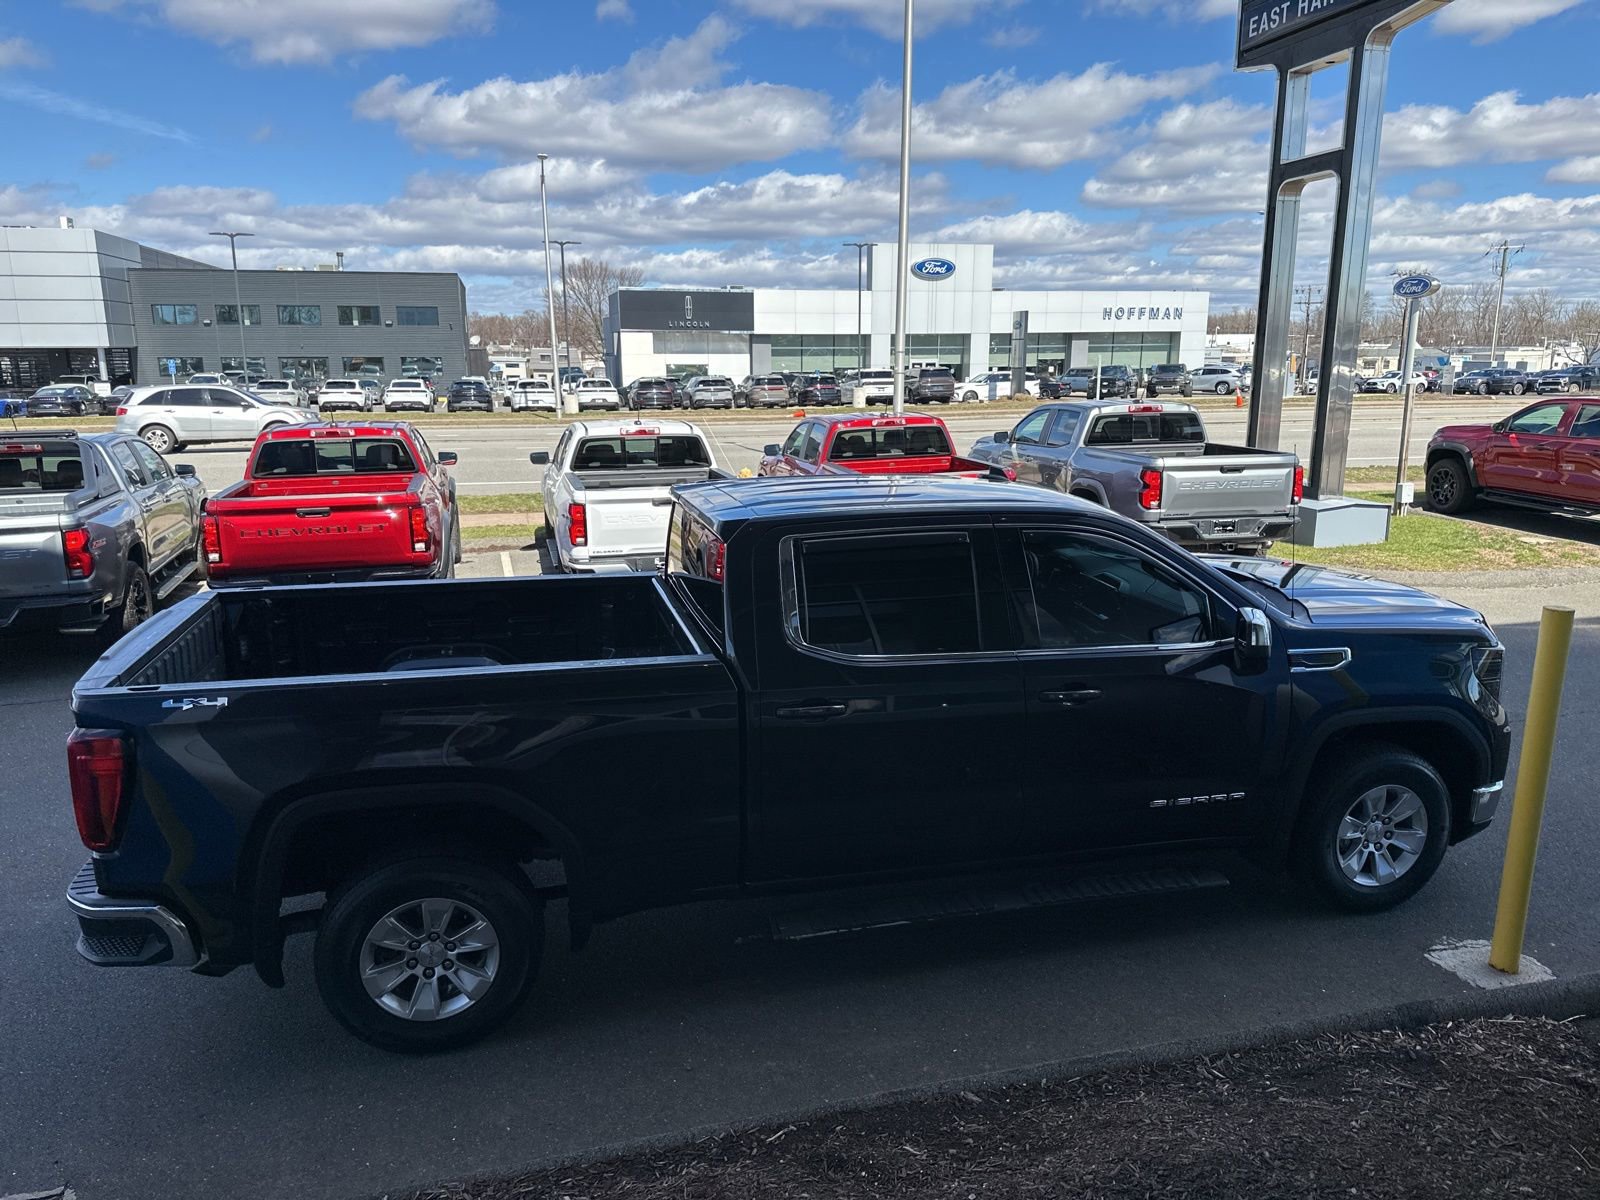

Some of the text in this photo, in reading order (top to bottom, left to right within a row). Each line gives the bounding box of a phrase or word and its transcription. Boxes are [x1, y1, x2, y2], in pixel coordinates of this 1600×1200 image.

[1248, 2, 1290, 38] EAST
[922, 261, 948, 273] Ford
[1400, 280, 1424, 293] Ford
[1102, 307, 1183, 320] HOFFMAN
[668, 320, 710, 328] LINCOLN
[1179, 479, 1283, 490] CHEVROLET
[239, 523, 389, 538] CHEVROLET
[1149, 792, 1246, 808] SIERRA
